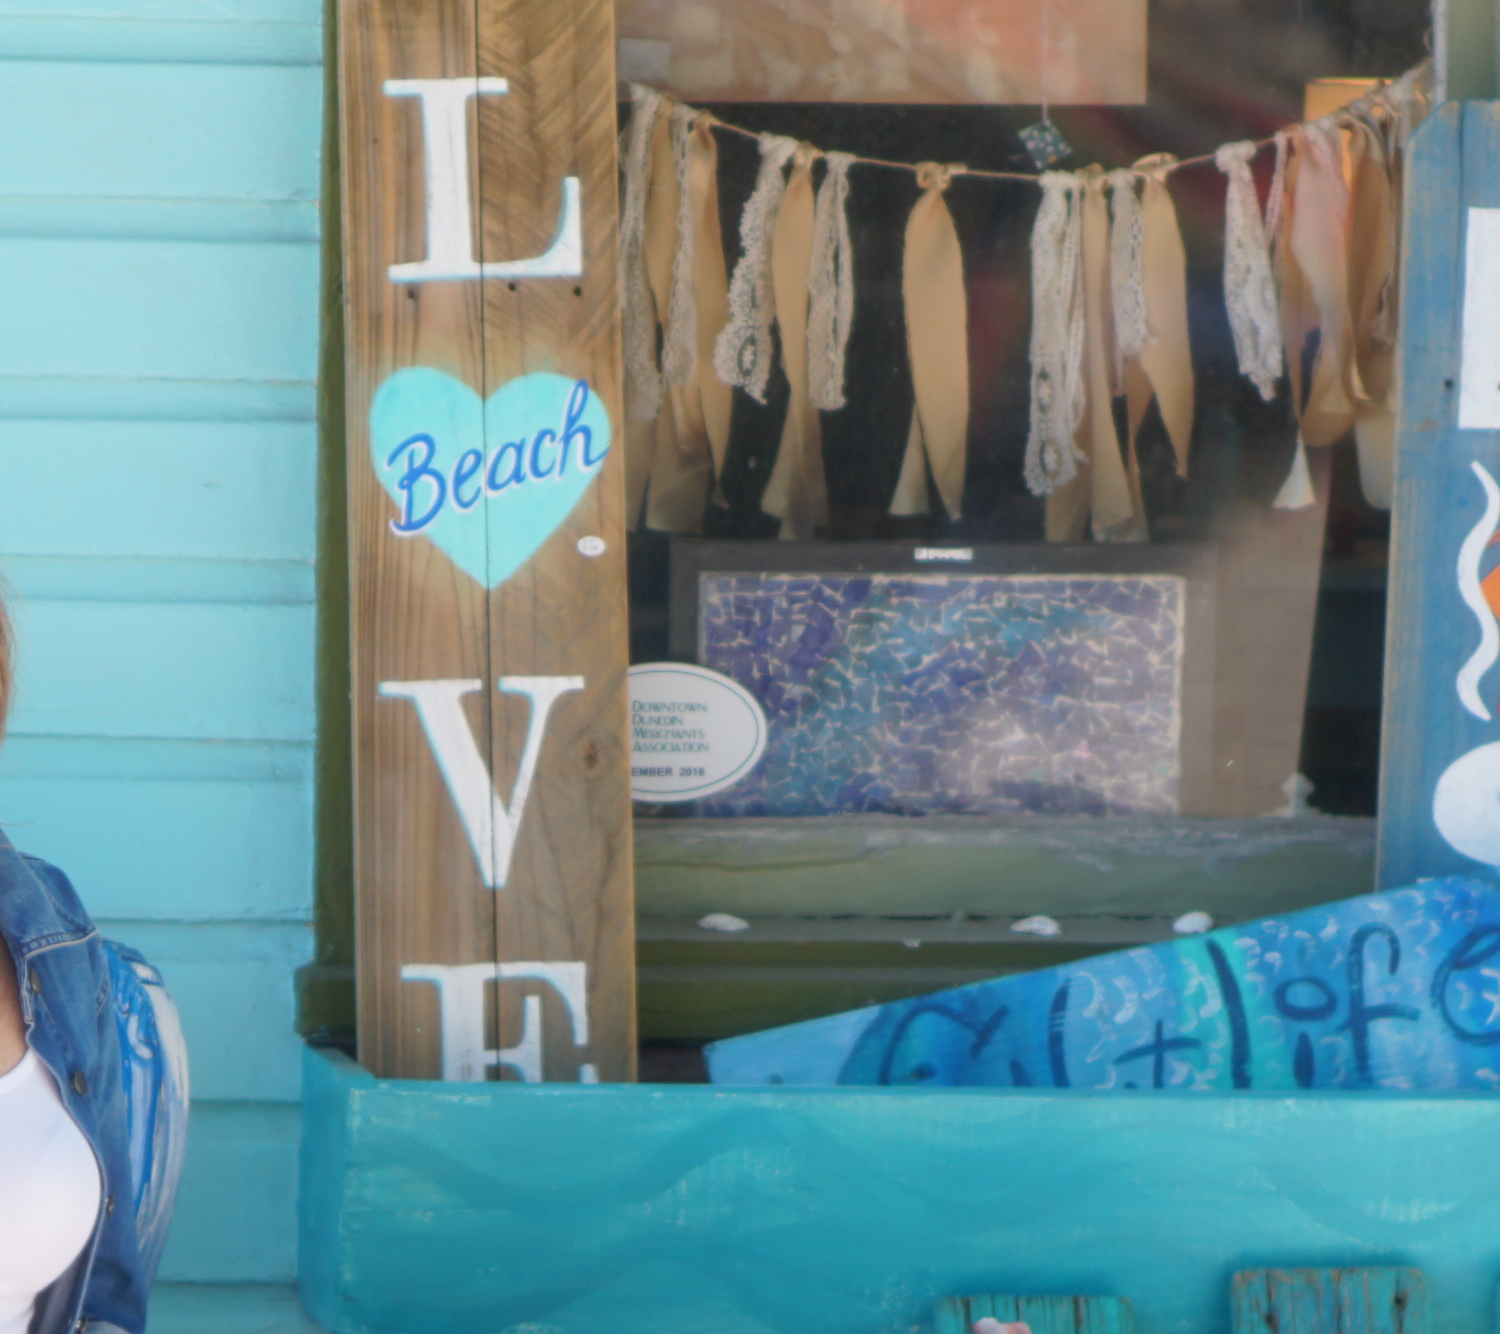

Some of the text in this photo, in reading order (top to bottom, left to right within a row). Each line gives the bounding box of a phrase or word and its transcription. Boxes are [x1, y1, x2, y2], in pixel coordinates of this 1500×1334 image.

[388, 380, 610, 537] Beach
[631, 767, 706, 777] EMBER 2016
